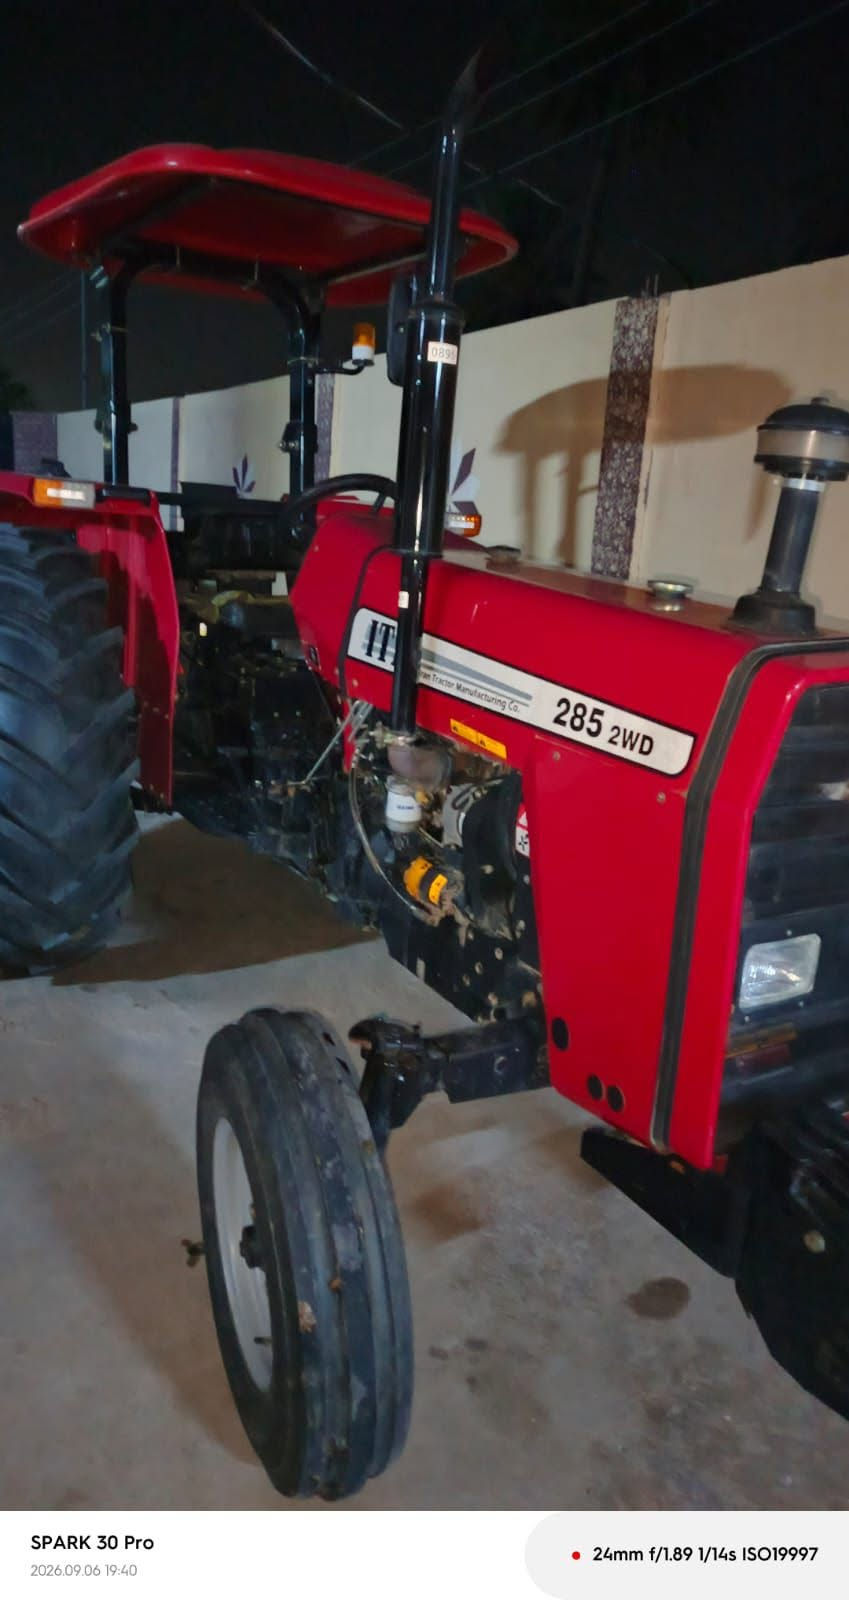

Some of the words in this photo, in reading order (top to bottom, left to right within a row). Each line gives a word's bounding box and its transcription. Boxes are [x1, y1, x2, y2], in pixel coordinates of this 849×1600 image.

[365, 619, 396, 666] IT
[432, 673, 454, 688] Tractor
[456, 682, 507, 711] Manufacturing
[508, 700, 520, 713] Co.
[553, 697, 605, 738] 285
[608, 725, 654, 756] 2WD
